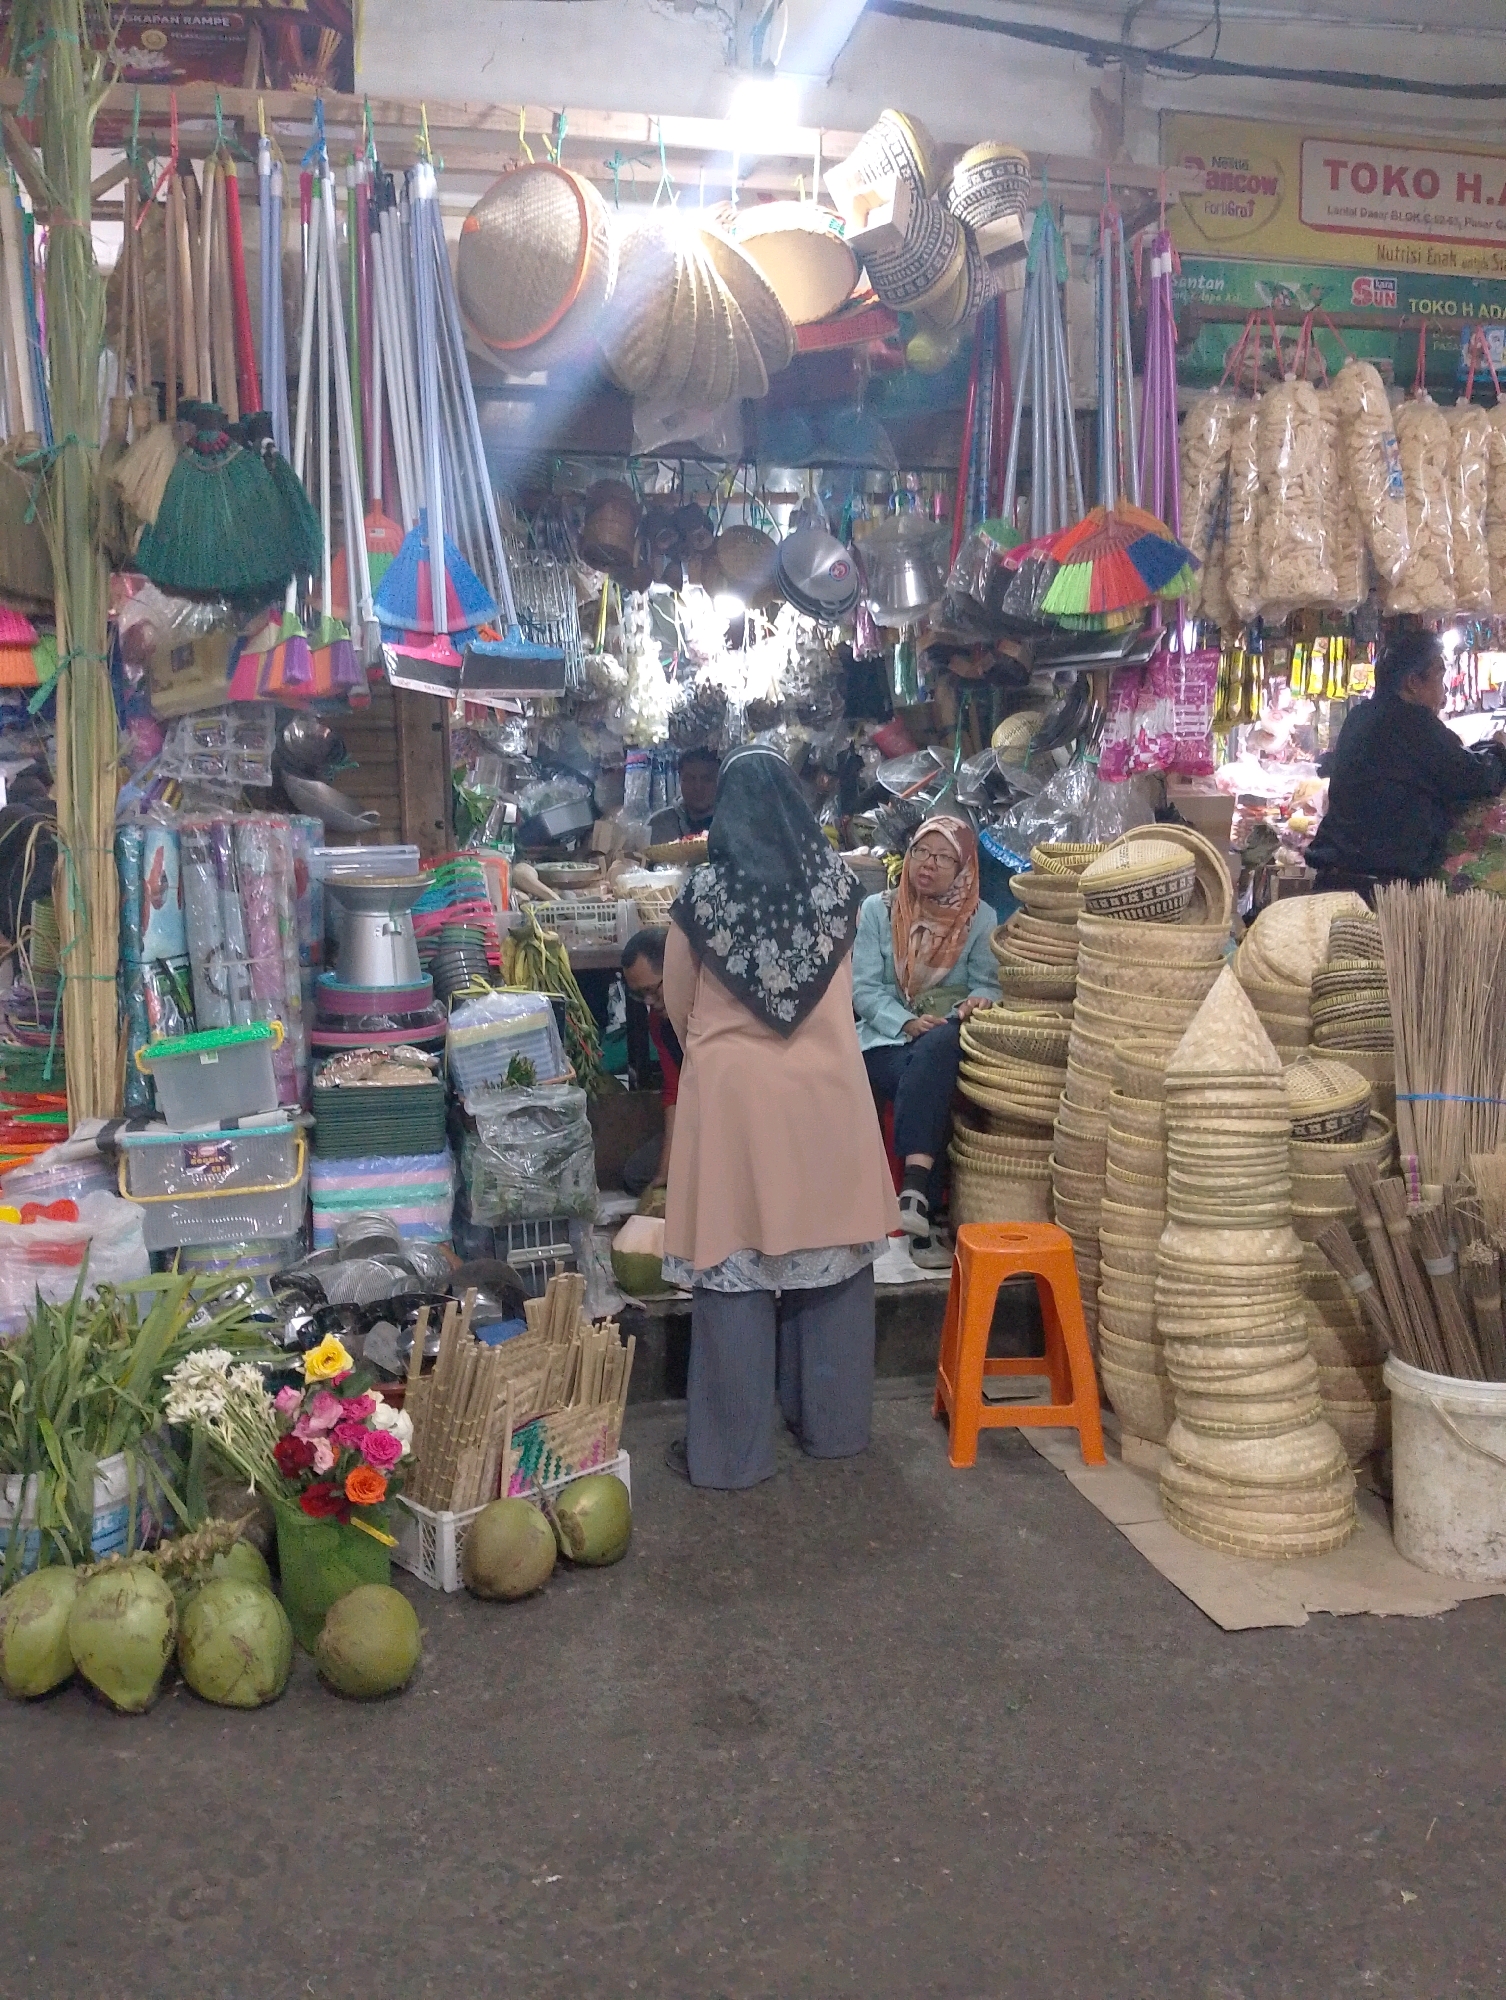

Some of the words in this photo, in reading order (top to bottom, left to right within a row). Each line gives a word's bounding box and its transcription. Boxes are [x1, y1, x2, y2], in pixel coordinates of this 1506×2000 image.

[182, 16, 231, 27] RAMPE
[1323, 159, 1440, 200] TOKO
[1456, 172, 1506, 207] H.
[1377, 244, 1421, 265] Nutrisi
[1427, 247, 1457, 268] Enak
[1171, 274, 1224, 291] Santan
[1409, 298, 1458, 316] TOKO
[1462, 301, 1474, 317] H
